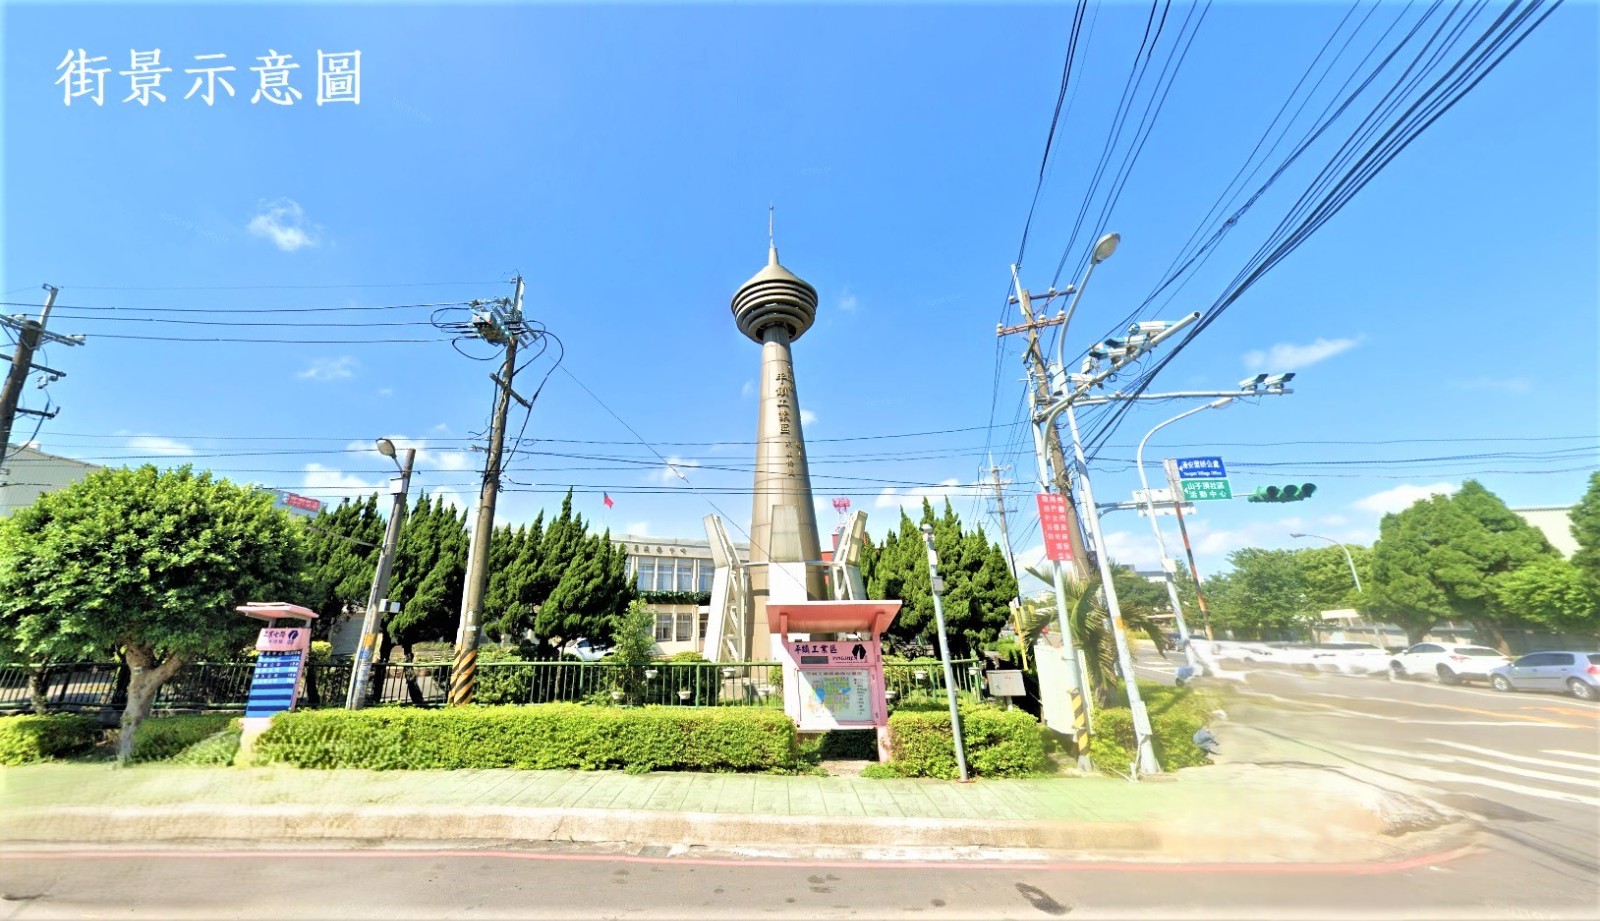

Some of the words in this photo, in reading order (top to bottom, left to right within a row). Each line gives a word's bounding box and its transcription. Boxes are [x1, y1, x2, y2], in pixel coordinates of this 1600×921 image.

[794, 644, 838, 654] 平鎮工業區
